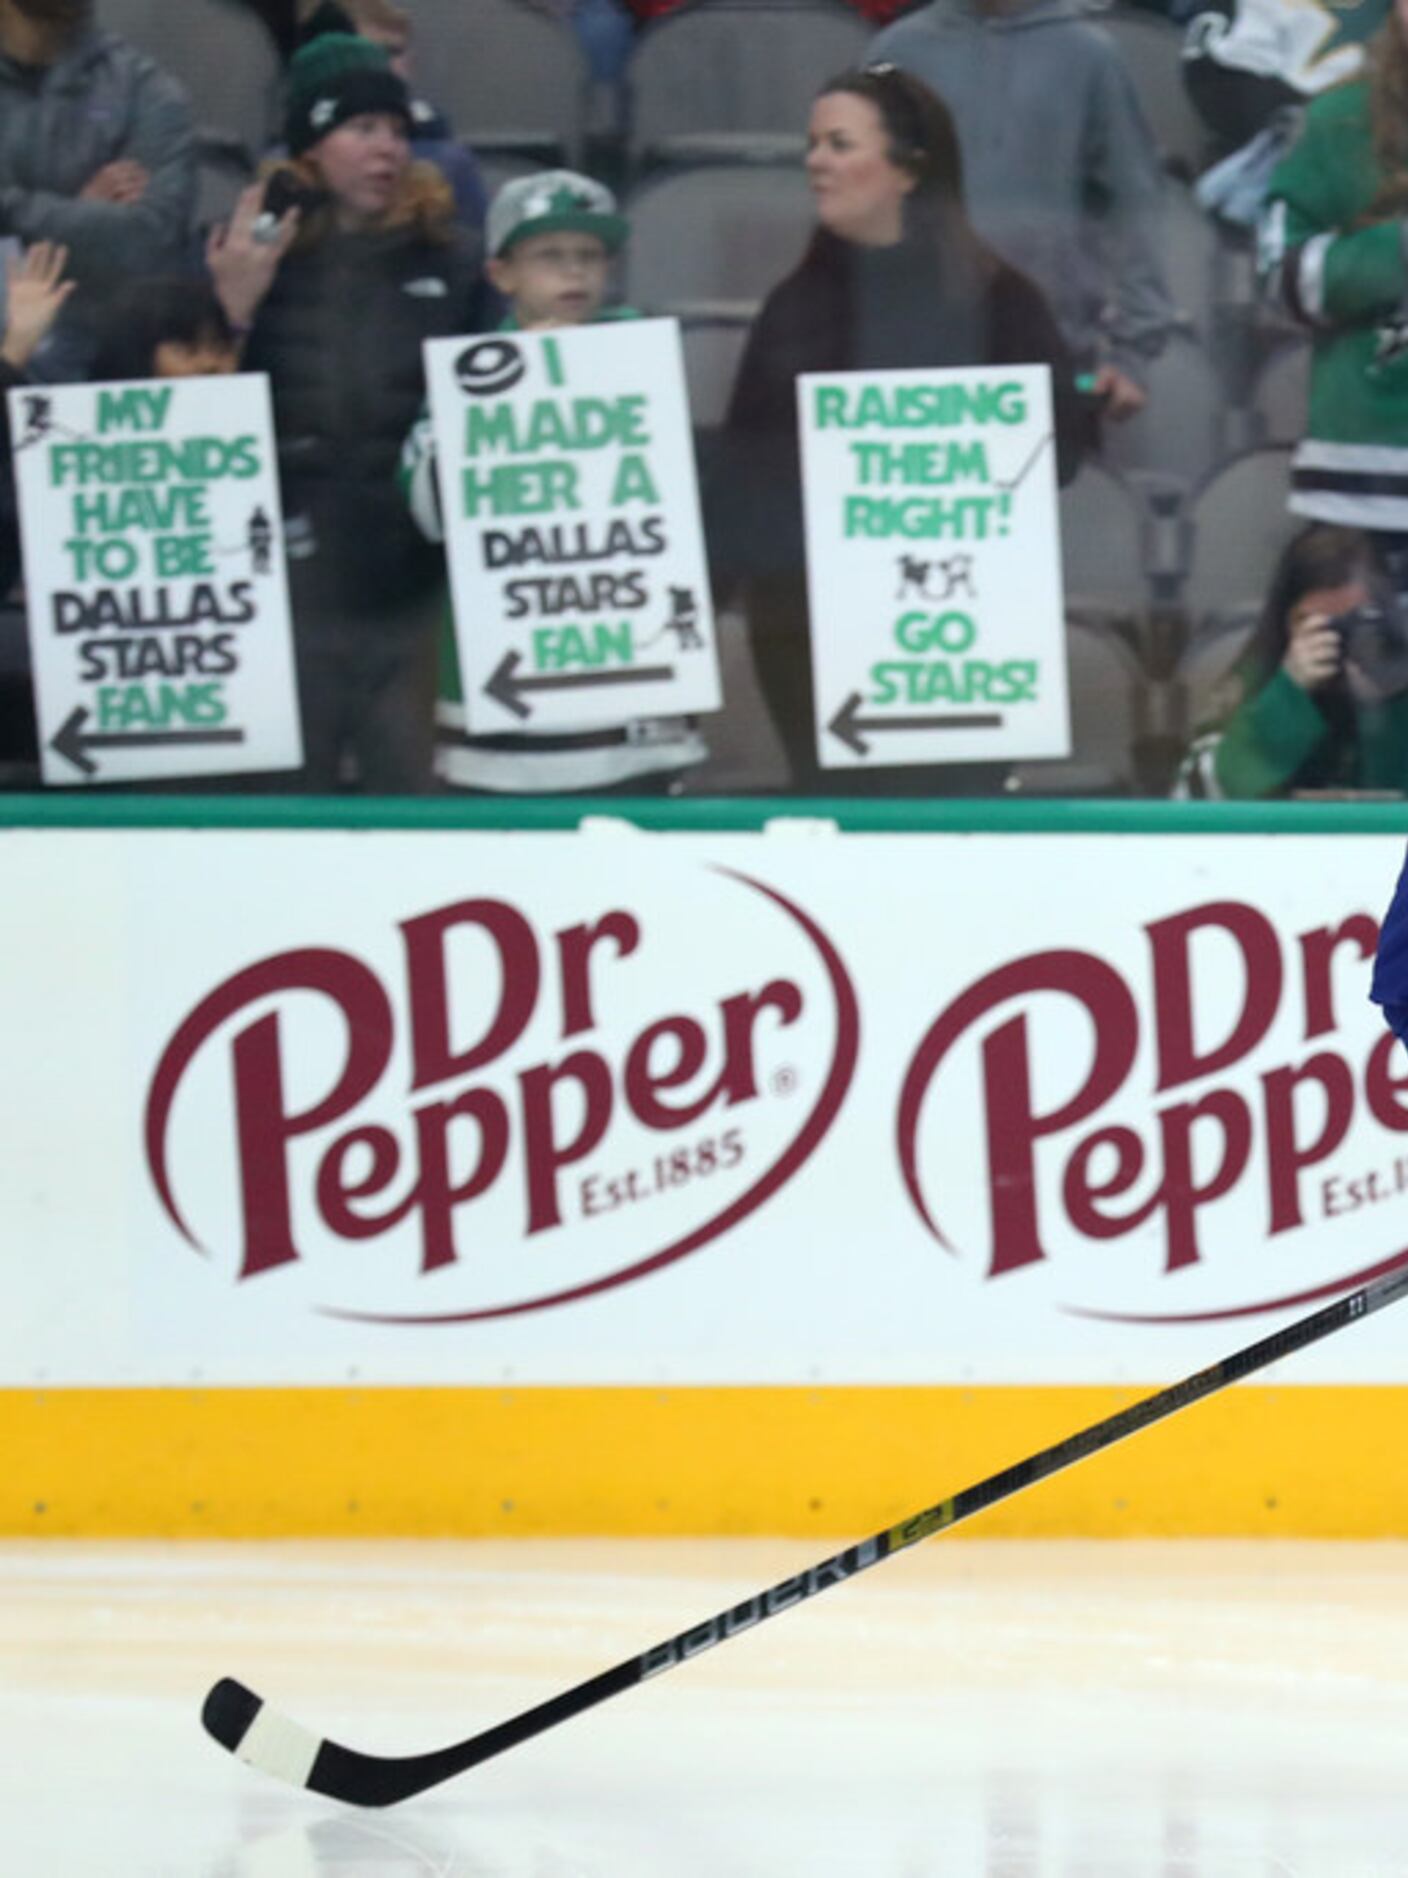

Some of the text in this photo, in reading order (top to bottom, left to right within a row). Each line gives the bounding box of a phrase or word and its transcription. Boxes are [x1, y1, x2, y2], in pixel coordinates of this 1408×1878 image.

[541, 338, 564, 386] I
[96, 387, 173, 434] MY
[464, 396, 651, 457] MADE
[814, 383, 1027, 428] RAISING
[49, 435, 261, 487] FRIENDS
[849, 441, 989, 485] THEM
[73, 487, 211, 534] HAVE
[462, 455, 660, 518] HER A
[843, 493, 1011, 539] RIGHT!
[63, 532, 216, 581] TO BE
[482, 518, 667, 568] DALLAS
[51, 582, 256, 633] DALLAS
[505, 573, 649, 618] STARS
[532, 620, 633, 669] FAN
[894, 612, 975, 653] GO
[79, 633, 239, 681] STARS
[870, 660, 1038, 703] STARS!
[98, 683, 228, 729] FANS
[394, 896, 640, 1040] Dr
[144, 945, 804, 1283] Pepper
